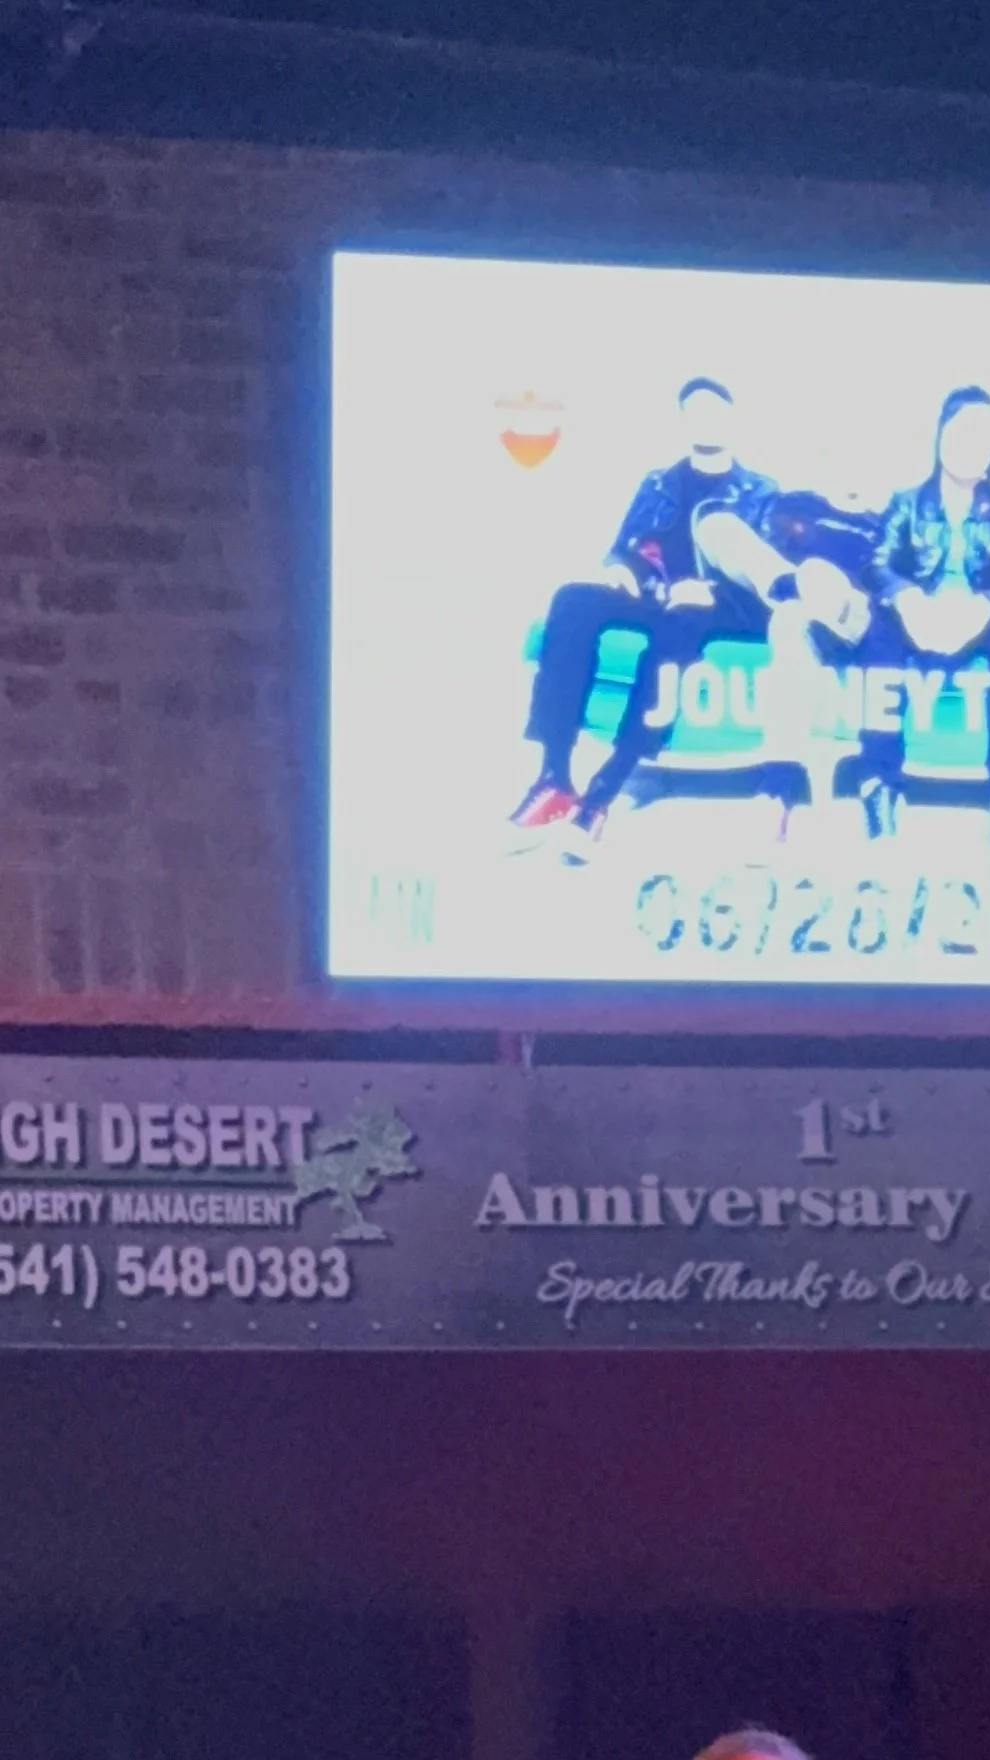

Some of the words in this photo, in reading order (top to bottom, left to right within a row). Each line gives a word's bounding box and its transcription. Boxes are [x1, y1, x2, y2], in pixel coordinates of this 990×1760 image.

[644, 663, 944, 733] JOUNEY
[101, 1103, 313, 1167] DESERT
[794, 1098, 887, 1159] 1st
[111, 1192, 299, 1226] MANAGEMENT
[473, 1171, 967, 1243] Anniversary
[116, 1245, 350, 1298] 548-0383
[536, 1260, 697, 1321] Special
[695, 1260, 834, 1309] Thanks
[840, 1268, 877, 1300] to
[886, 1259, 973, 1304] Our
